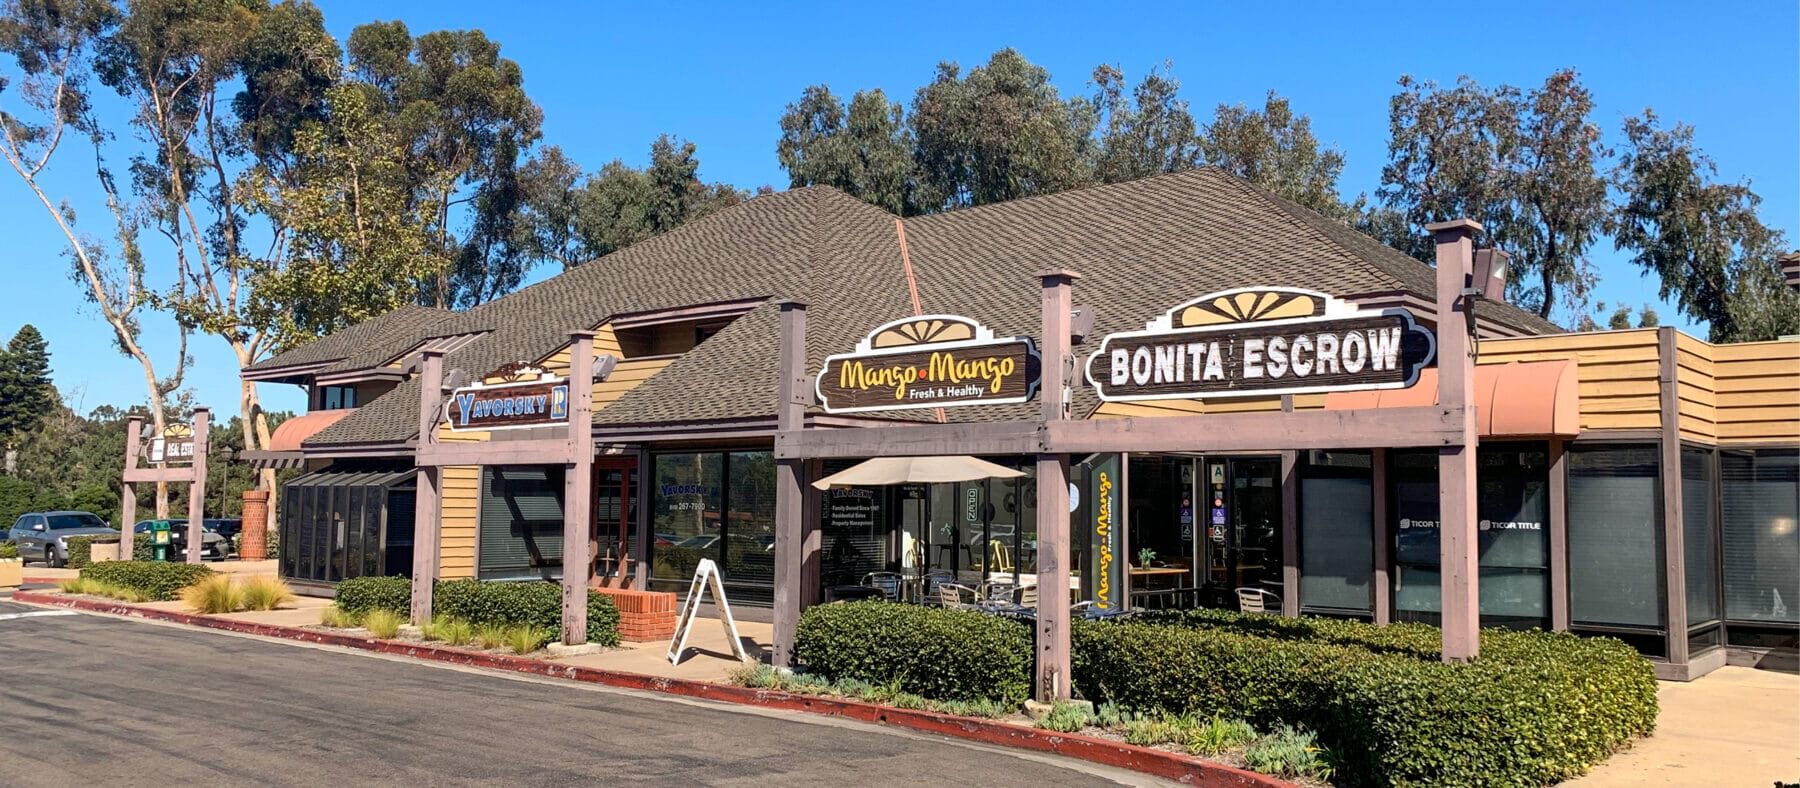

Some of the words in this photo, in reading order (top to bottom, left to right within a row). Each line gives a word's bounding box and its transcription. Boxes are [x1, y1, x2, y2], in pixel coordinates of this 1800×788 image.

[1110, 341, 1226, 386] BONITA
[1242, 327, 1401, 379] ESCROW
[909, 387, 935, 399] Fresh
[937, 387, 945, 397] &
[946, 385, 984, 398] Healthy
[456, 393, 547, 425] YAVORSKY
[166, 442, 180, 457] REAL
[968, 490, 976, 519] OPEN
[1411, 520, 1434, 528] TICOR
[1491, 521, 1516, 529] TICOR
[1516, 521, 1541, 529] TITLE
